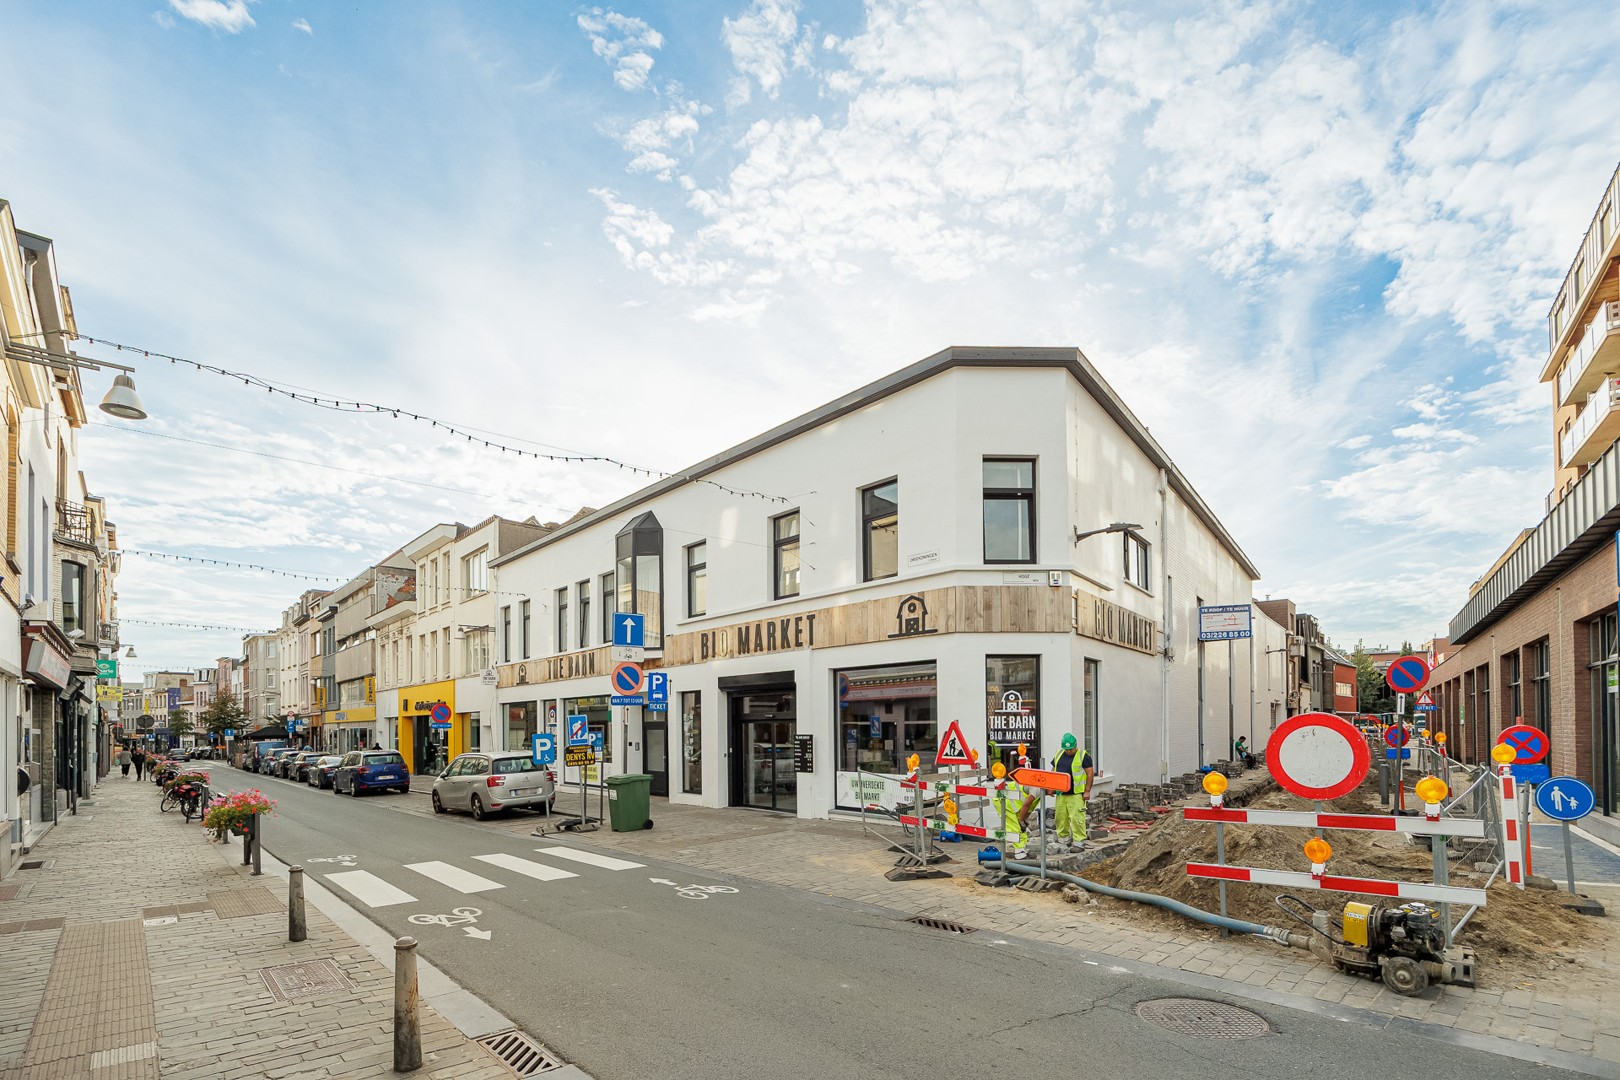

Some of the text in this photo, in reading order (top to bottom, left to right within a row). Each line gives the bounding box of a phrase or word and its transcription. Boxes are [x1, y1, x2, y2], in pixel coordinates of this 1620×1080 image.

[1094, 600, 1153, 651] BIO MARKET
[701, 614, 815, 660] BIO MARKET
[547, 652, 595, 680] THE BARN
[652, 675, 663, 690] P
[989, 716, 1036, 729] THE BARN
[990, 731, 1035, 740] BIO MARKET
[535, 738, 551, 760] P
[566, 752, 595, 761] DENYS NV
[860, 780, 885, 790] VERDEKTE
[864, 792, 880, 801] MARKT
